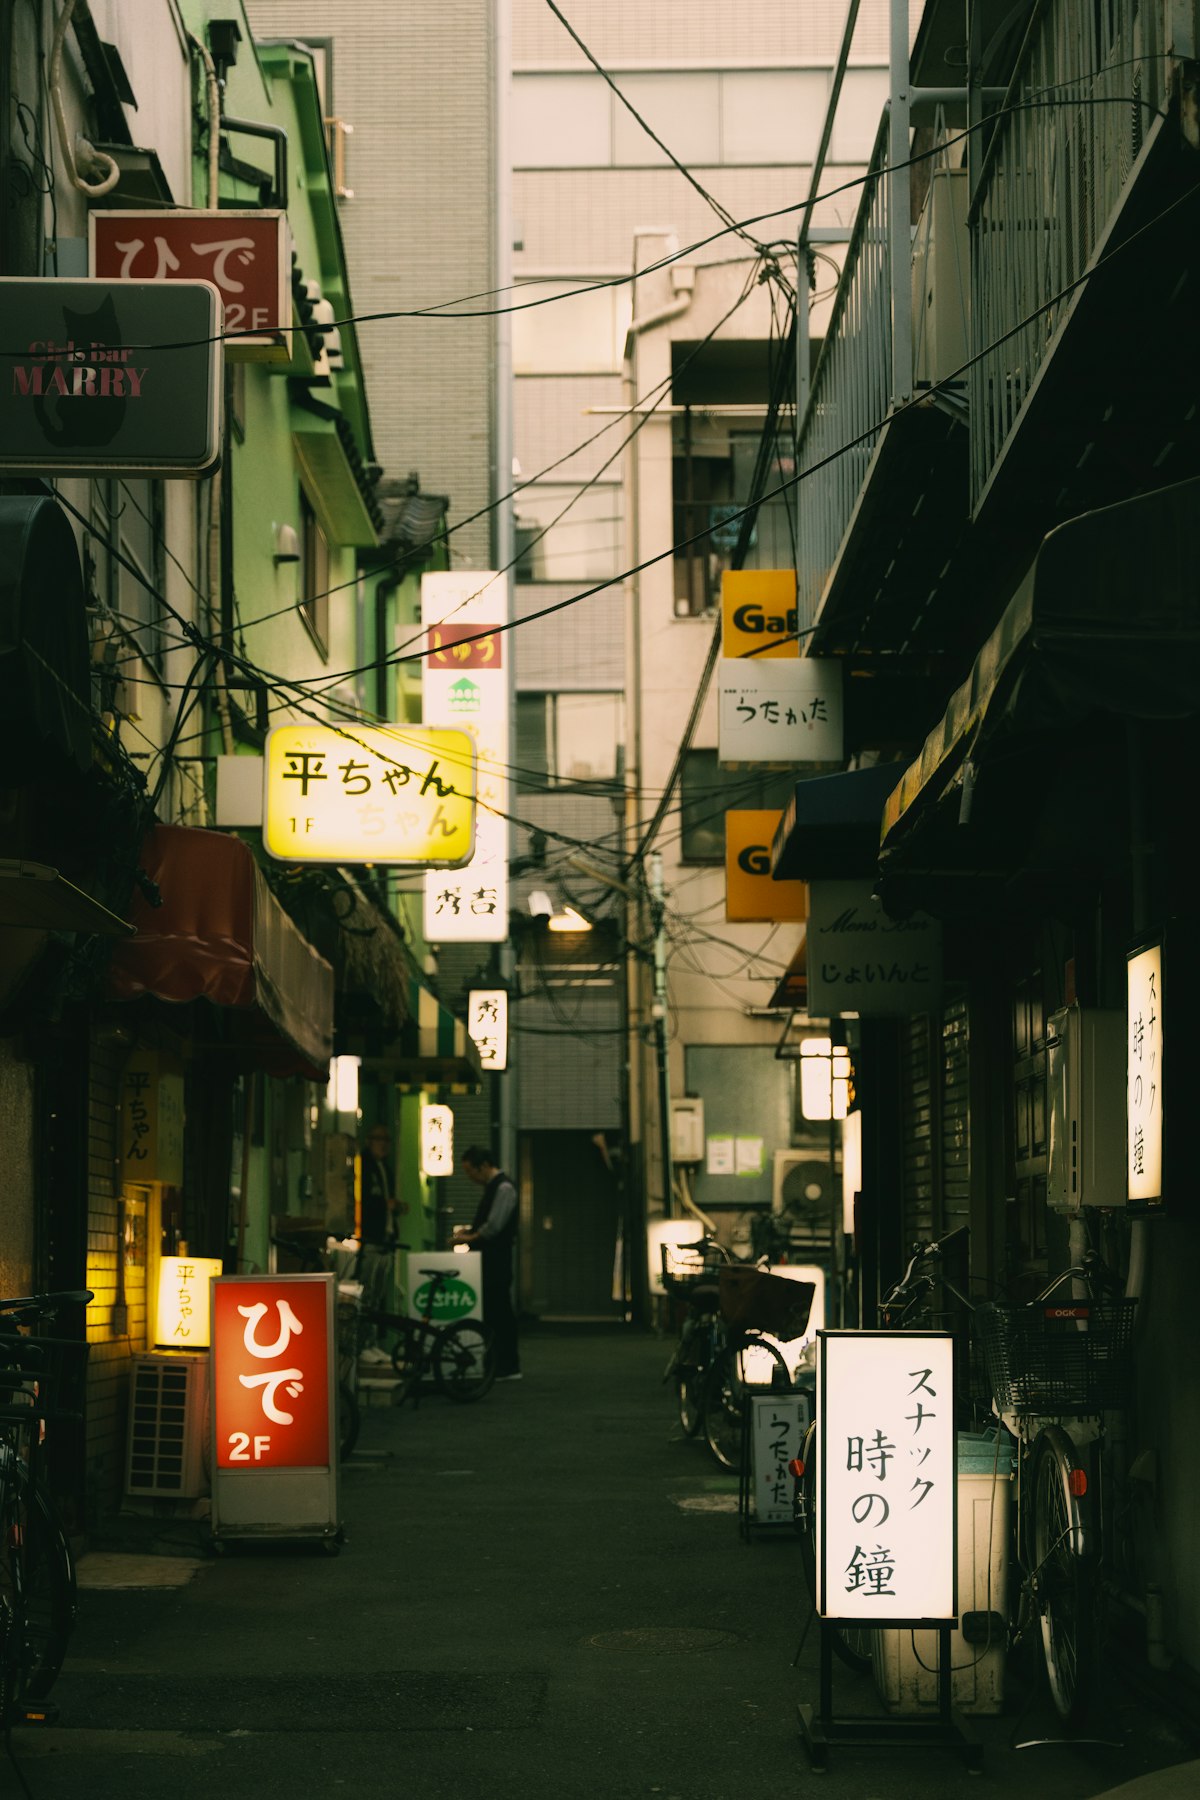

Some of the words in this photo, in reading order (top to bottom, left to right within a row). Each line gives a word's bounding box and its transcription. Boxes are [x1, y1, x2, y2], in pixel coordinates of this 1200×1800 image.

[114, 236, 256, 293] ひで
[224, 303, 270, 332] 2F
[28, 341, 86, 363] Girls
[89, 342, 134, 363] Bar
[12, 366, 149, 397] MARRY
[736, 697, 828, 726] うたかた
[282, 752, 455, 797] 平ちゃん
[289, 817, 315, 833] 1F
[821, 962, 931, 984] じょいんと
[126, 1072, 150, 1160] 平ちゃん
[173, 1265, 195, 1337] 平ちゃん
[1055, 1308, 1077, 1317] OGK
[237, 1299, 304, 1426] ひで
[228, 1432, 271, 1461] 2F
[904, 1368, 937, 1511] スナック
[844, 1429, 897, 1597] 時の鐘
